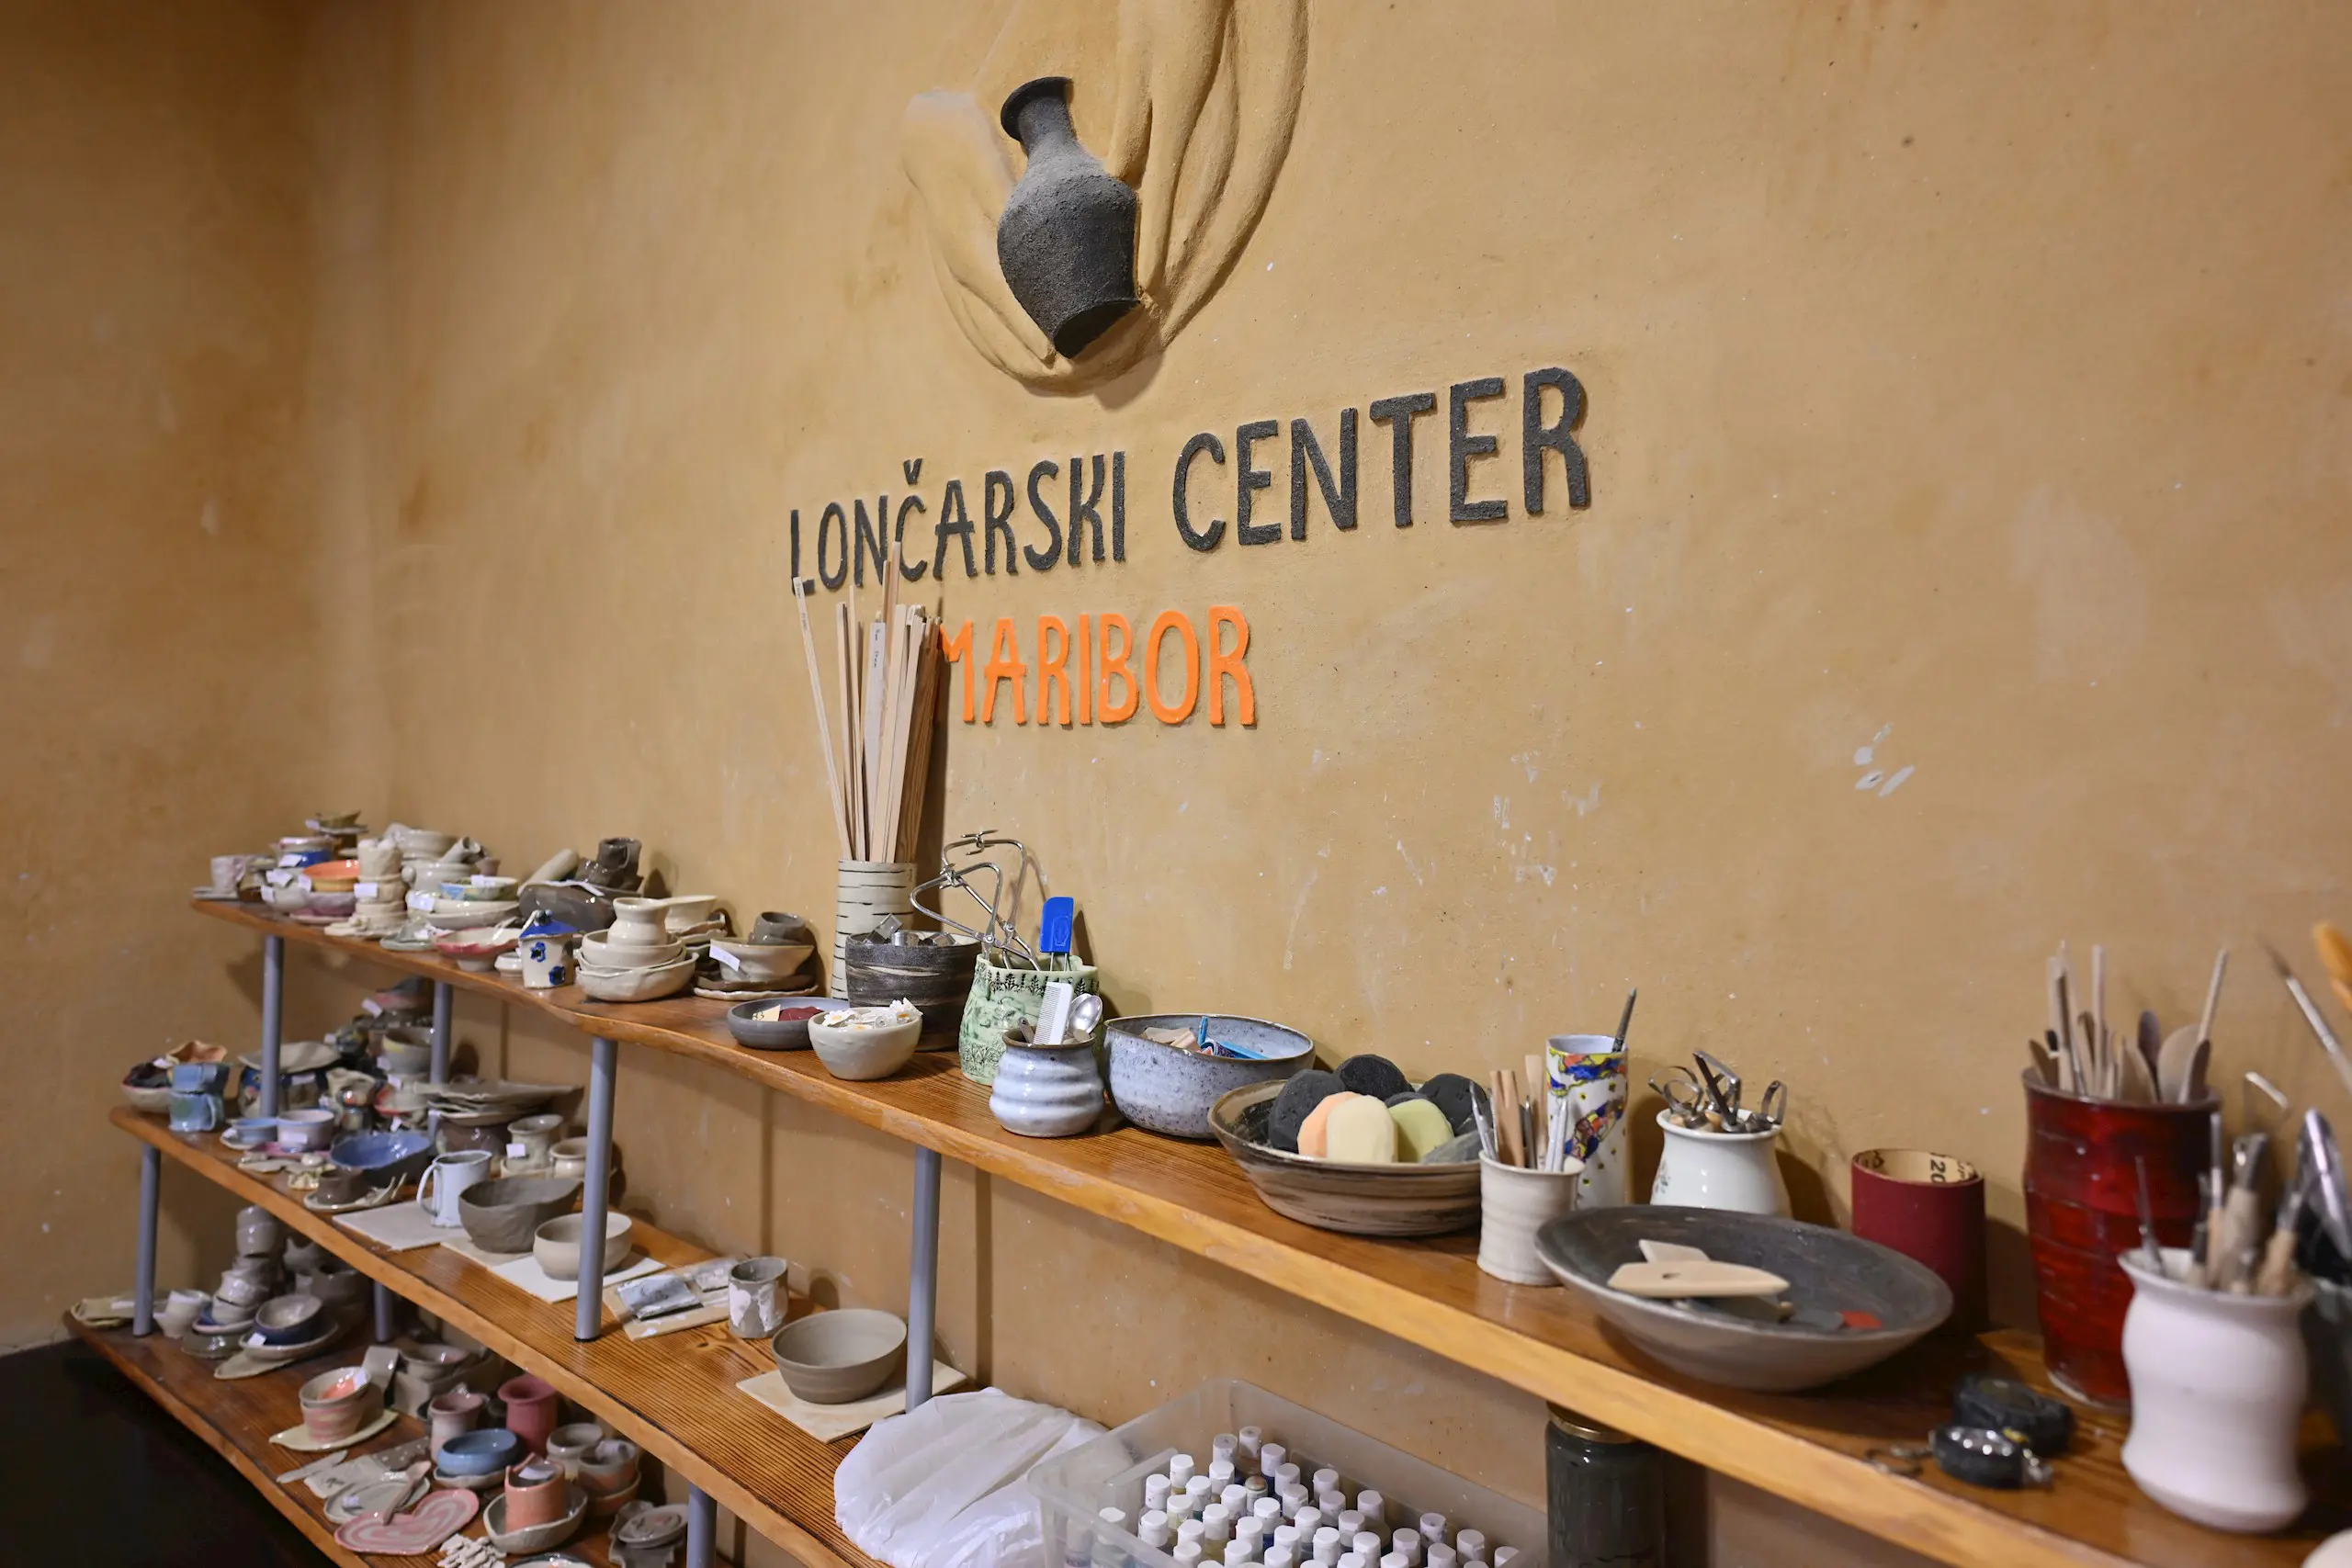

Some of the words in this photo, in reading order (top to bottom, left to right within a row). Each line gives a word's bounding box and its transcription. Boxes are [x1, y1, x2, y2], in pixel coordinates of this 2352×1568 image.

[791, 451, 1125, 596] LONČARSKI
[1172, 367, 1589, 551] CENTER
[940, 605, 1256, 726] MARIBOR
